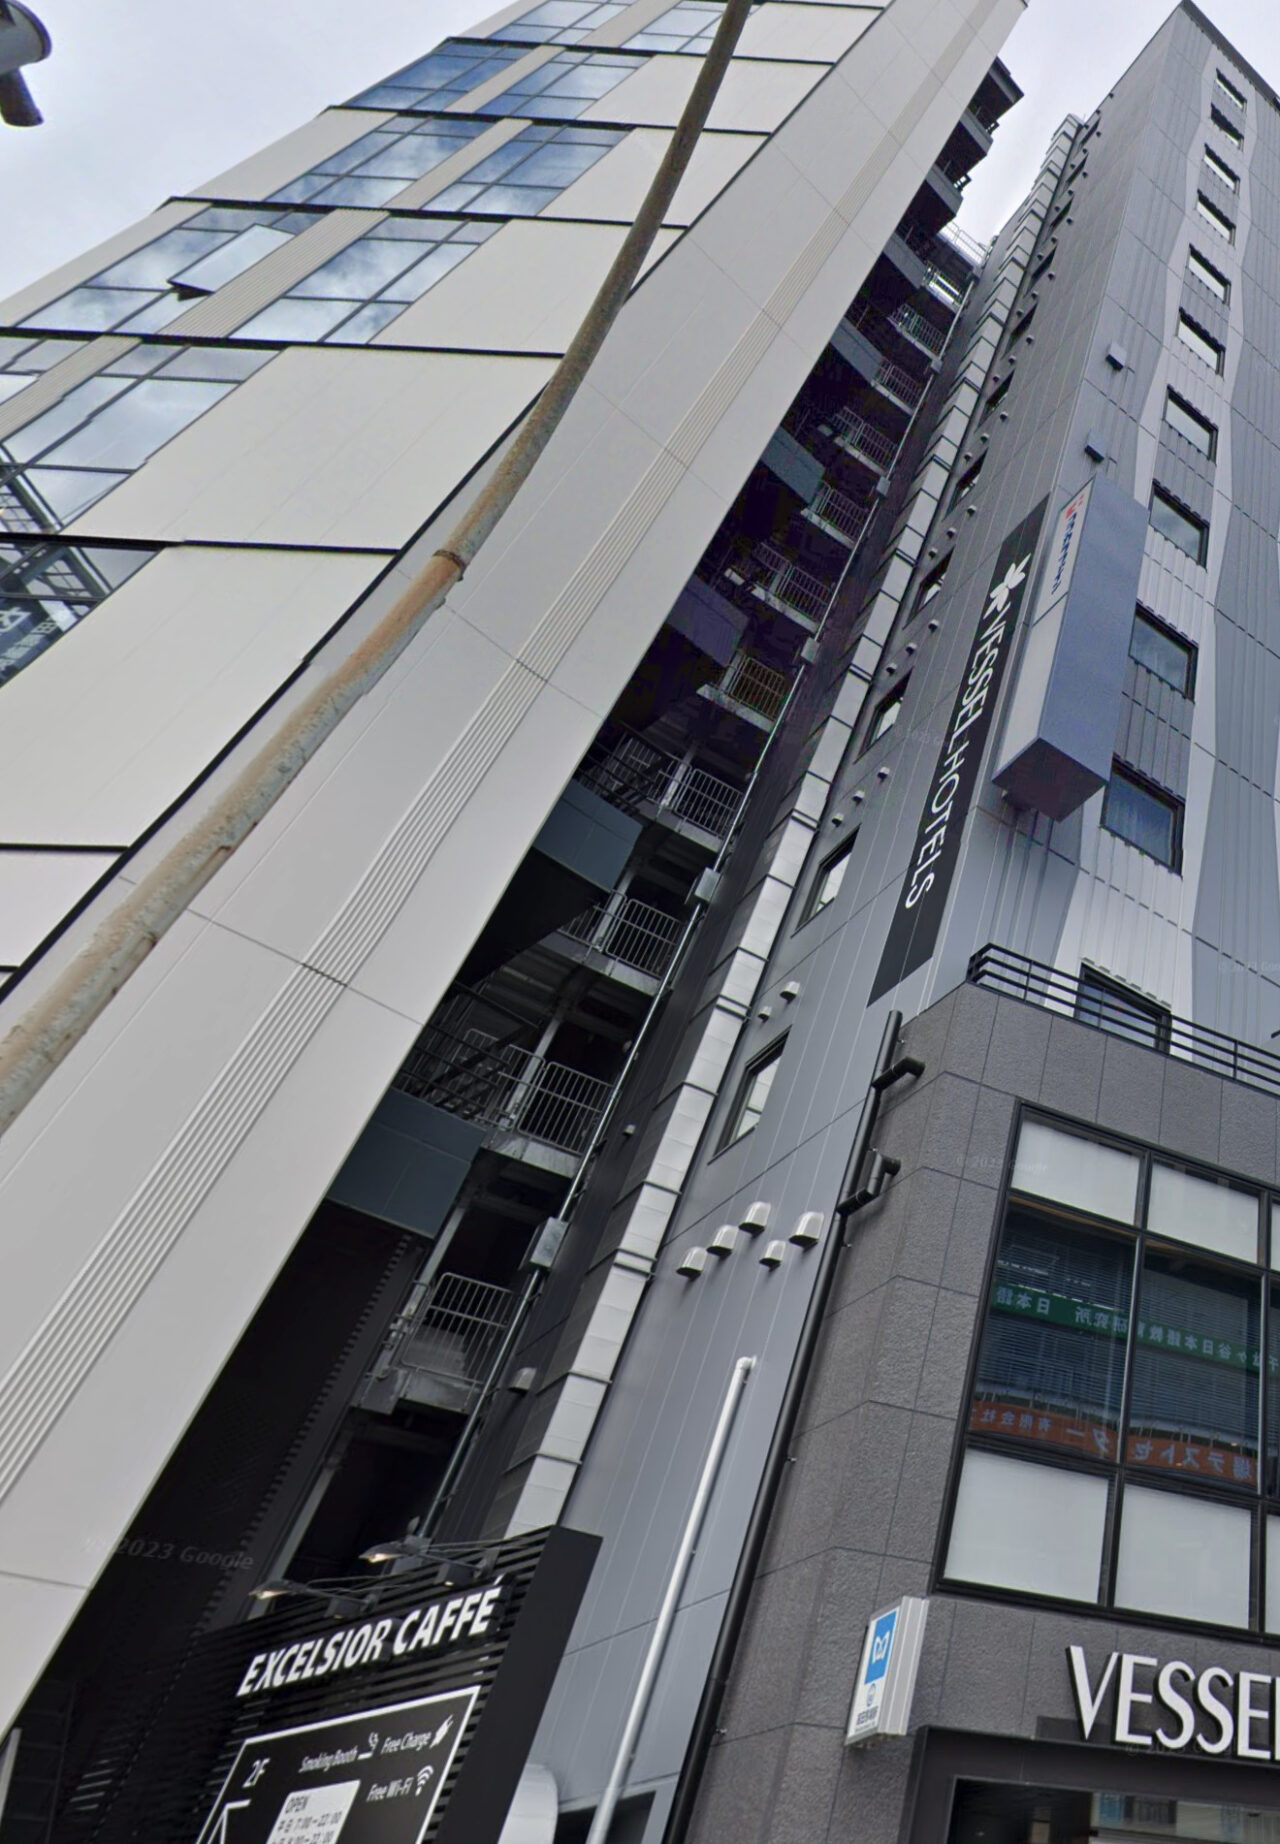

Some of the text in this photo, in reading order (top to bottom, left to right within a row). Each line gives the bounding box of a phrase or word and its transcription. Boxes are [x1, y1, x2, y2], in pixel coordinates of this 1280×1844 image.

[948, 601, 1011, 754] VESSEL
[905, 740, 969, 909] HOTELS
[237, 1575, 502, 1697] EXCELSIOR CAFFÉ
[381, 1731, 432, 1755] Free Charge
[242, 1758, 270, 1788] 2F
[298, 1754, 332, 1773] Smoking
[366, 1776, 414, 1802] Free Wi-Fi
